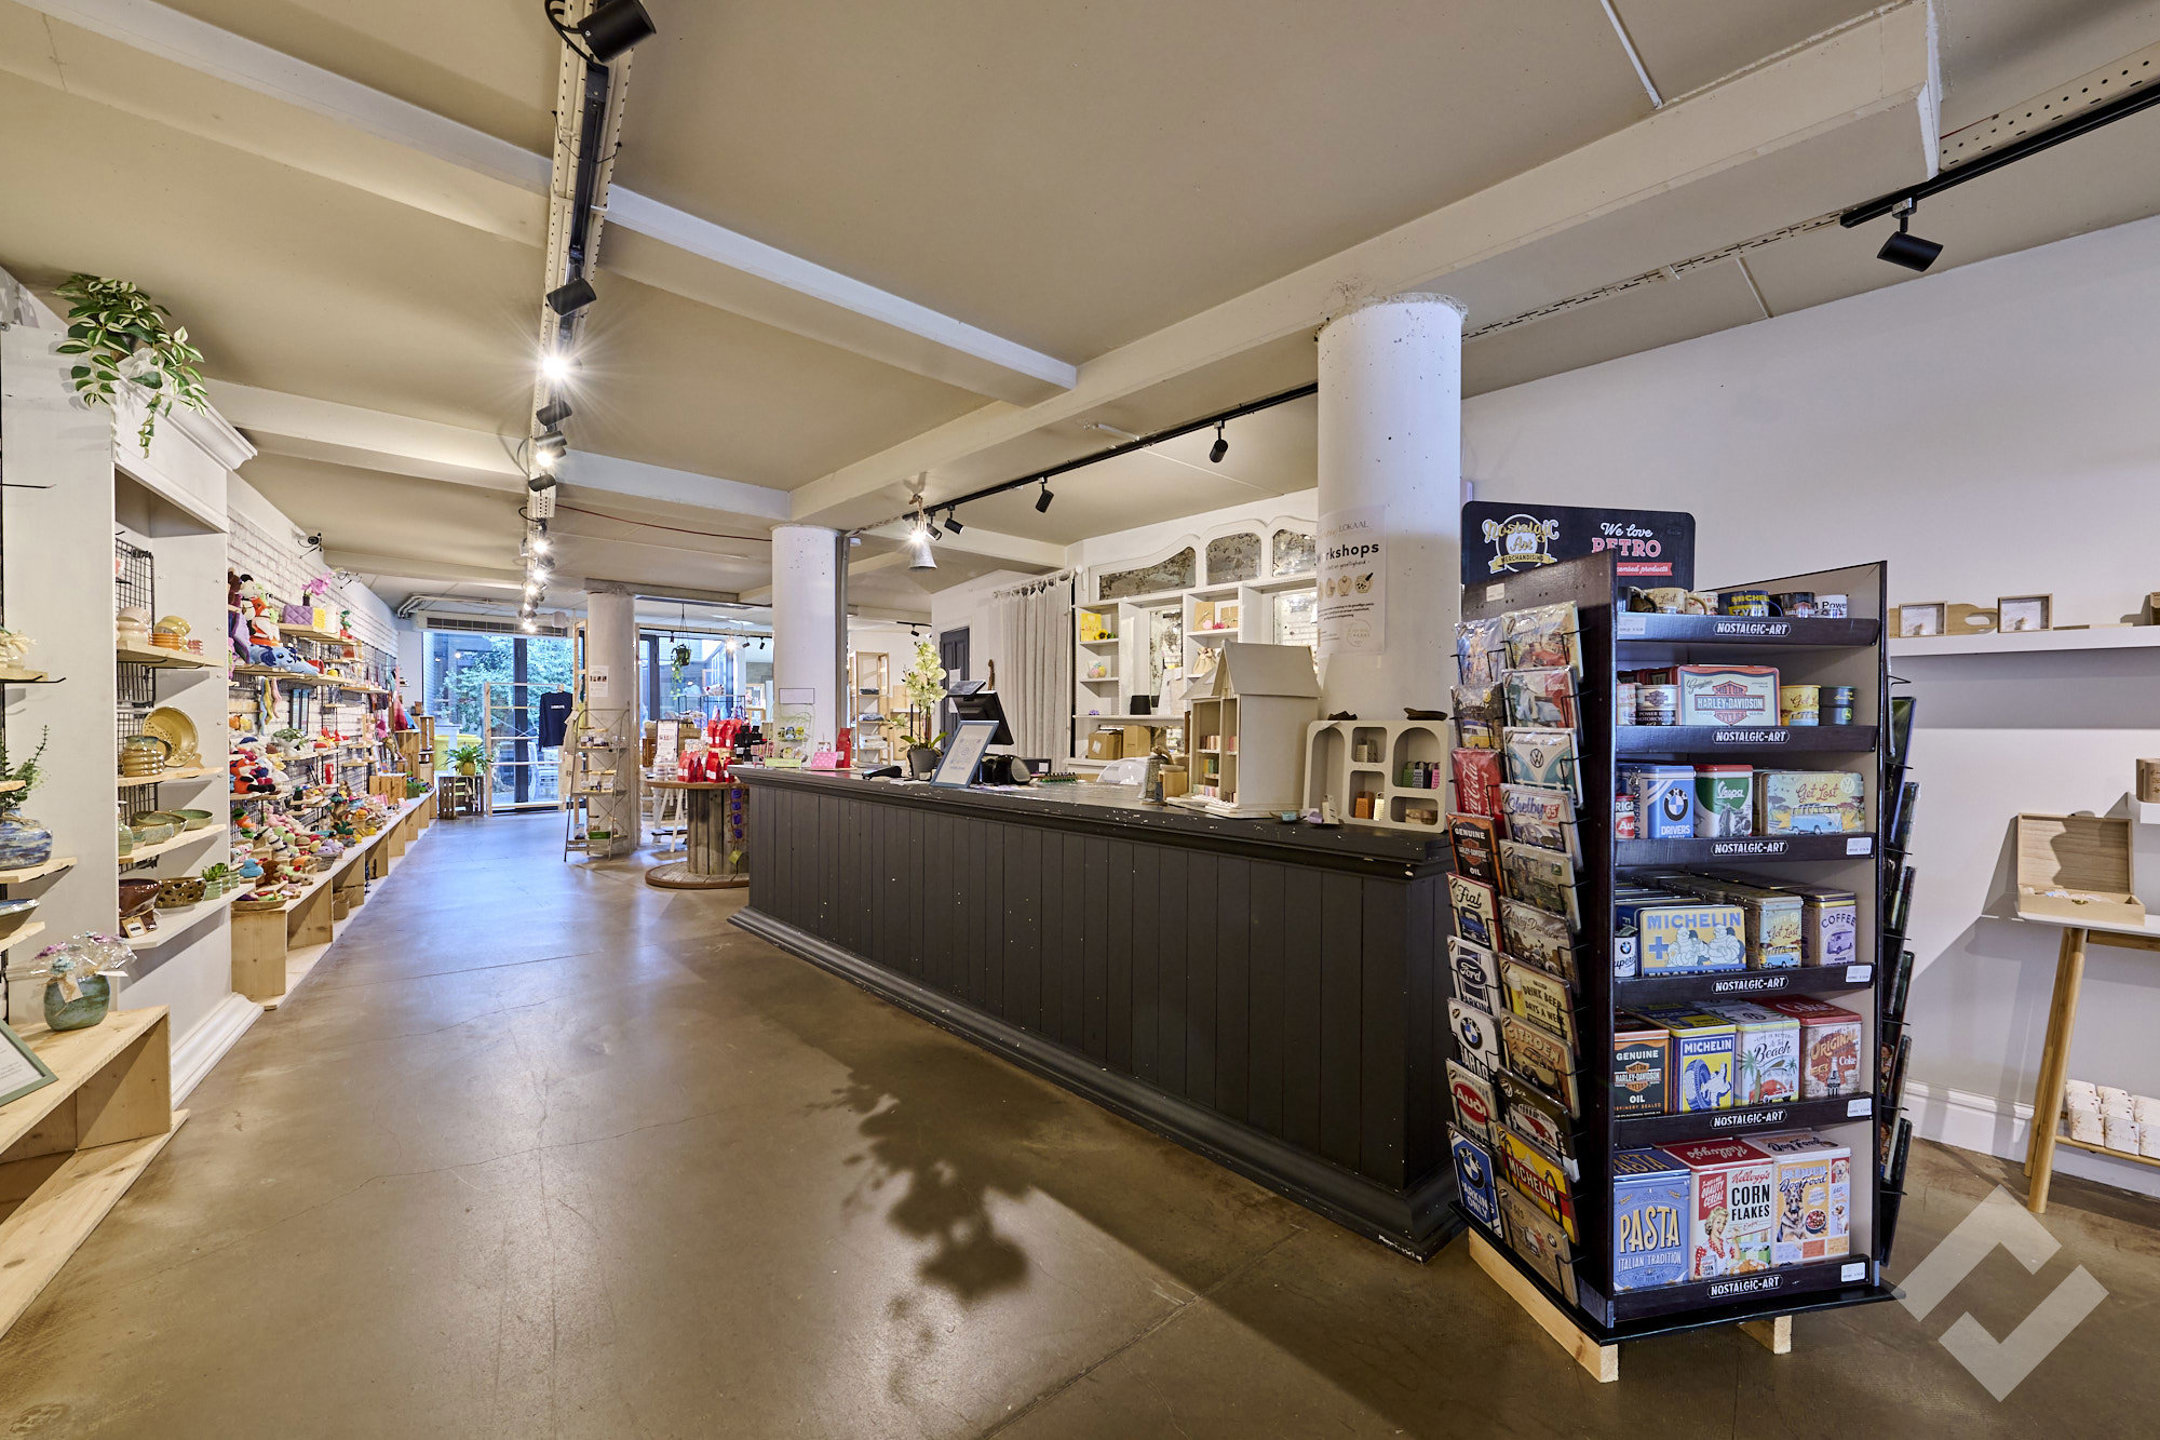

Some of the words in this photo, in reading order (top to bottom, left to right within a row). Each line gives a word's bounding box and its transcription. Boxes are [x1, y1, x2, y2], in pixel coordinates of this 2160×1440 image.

[1600, 522, 1623, 537] We
[1627, 523, 1653, 538] love
[1509, 535, 1534, 551] Art
[1321, 543, 1379, 560] rkshops
[1500, 553, 1545, 563] MERCHANDISING
[1639, 564, 1669, 576] products
[1731, 594, 1769, 603] MICHEL
[1822, 601, 1847, 609] Powe
[1716, 622, 1788, 635] NOSTALGIC-ART
[1696, 697, 1764, 710] HARLEY-DAVIDSON
[1715, 731, 1786, 742] NOSTALGIC-ART
[1716, 781, 1745, 800] Vespa
[1796, 783, 1817, 803] Get
[1815, 783, 1840, 801] Lost
[1508, 796, 1544, 820] Shelby
[1454, 828, 1486, 840] GENUINE
[1618, 821, 1634, 831] Au
[1661, 824, 1690, 836] DRIVERS
[1714, 842, 1784, 854] NOSTALGIC-ART
[1469, 867, 1482, 876] OIL
[1456, 885, 1482, 906] Fiat
[1646, 912, 1741, 930] MICHELIN
[1821, 913, 1856, 929] COFFEE
[1460, 962, 1482, 982] Ford
[1715, 978, 1786, 992] NOSTALGIC-ART
[1684, 1040, 1732, 1054] MICHELIN
[1754, 1041, 1791, 1062] Beach
[1810, 1029, 1858, 1060] ORIGINAL
[1616, 1050, 1659, 1061] GENUINE
[1839, 1056, 1857, 1066] Coke
[1615, 1072, 1660, 1082] HARLEY-DAVIDSON
[1456, 1088, 1488, 1117] Audi
[1629, 1094, 1646, 1104] OIL
[1714, 1110, 1784, 1127] NOSTALGIC-ART
[1686, 1144, 1748, 1160] Kellogg's
[1508, 1155, 1557, 1206] MICHELIN
[1732, 1170, 1770, 1184] Kellogg's
[1779, 1178, 1804, 1193] Dog
[1801, 1172, 1828, 1189] Food
[1702, 1182, 1724, 1196] QUALITY
[1732, 1184, 1770, 1206] CORN
[1467, 1195, 1488, 1219] ONLY
[1703, 1194, 1724, 1208] CEREAL
[1732, 1204, 1770, 1222] FLAKES
[1620, 1206, 1681, 1254] PASTA
[1618, 1256, 1644, 1272] ITALIAN
[1646, 1252, 1682, 1268] TRADITION
[1711, 1276, 1780, 1296] NOSTALGIC-ART
